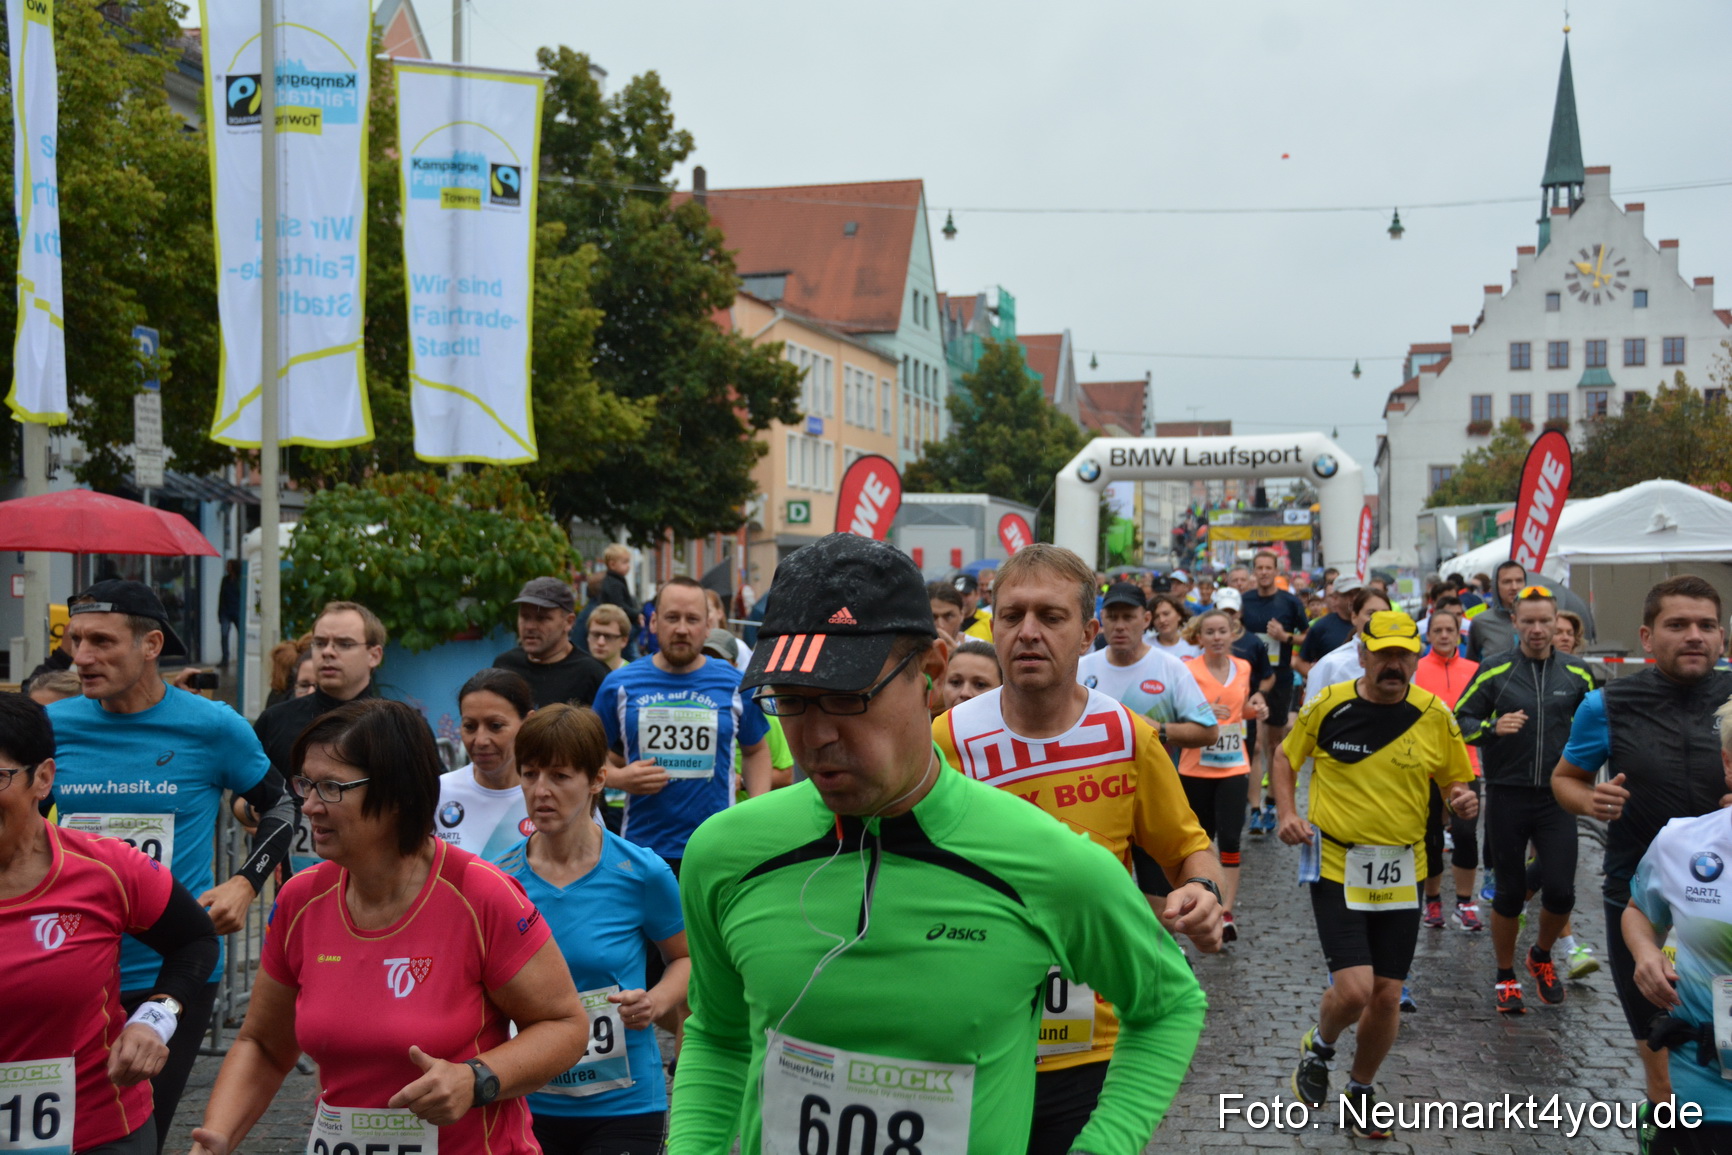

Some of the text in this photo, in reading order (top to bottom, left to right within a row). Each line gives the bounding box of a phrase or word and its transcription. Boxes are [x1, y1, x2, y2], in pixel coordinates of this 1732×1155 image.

[413, 159, 480, 175] Kampagne
[443, 192, 481, 205] Towns
[411, 273, 503, 298] Wir sind
[412, 304, 519, 331] Fairtrade-
[416, 335, 481, 357] Stadt!
[1109, 445, 1303, 469] BMW Laufsport
[788, 502, 809, 522] D
[847, 471, 892, 540] WE
[1515, 450, 1565, 571] REWE
[828, 617, 858, 626] adidas
[635, 690, 718, 709] Wyk auf Föhr
[647, 724, 710, 751] 2336
[1332, 740, 1373, 754] Heinz L.
[652, 756, 702, 769] Alexander
[60, 779, 179, 795] www.hasit.de
[1053, 773, 1138, 808] BÖGL
[108, 817, 165, 831] BOCK
[1362, 859, 1402, 886] 145
[1369, 892, 1394, 903] Heinz
[1685, 885, 1722, 898] PARTL
[1685, 895, 1721, 905] Neumarkt
[946, 928, 988, 942] asics
[551, 1068, 597, 1085] ndrea
[778, 1055, 835, 1083] NeuerMarkt
[848, 1059, 954, 1094] BOCK
[351, 1112, 425, 1131] BOCK
[798, 1093, 925, 1155] 608
